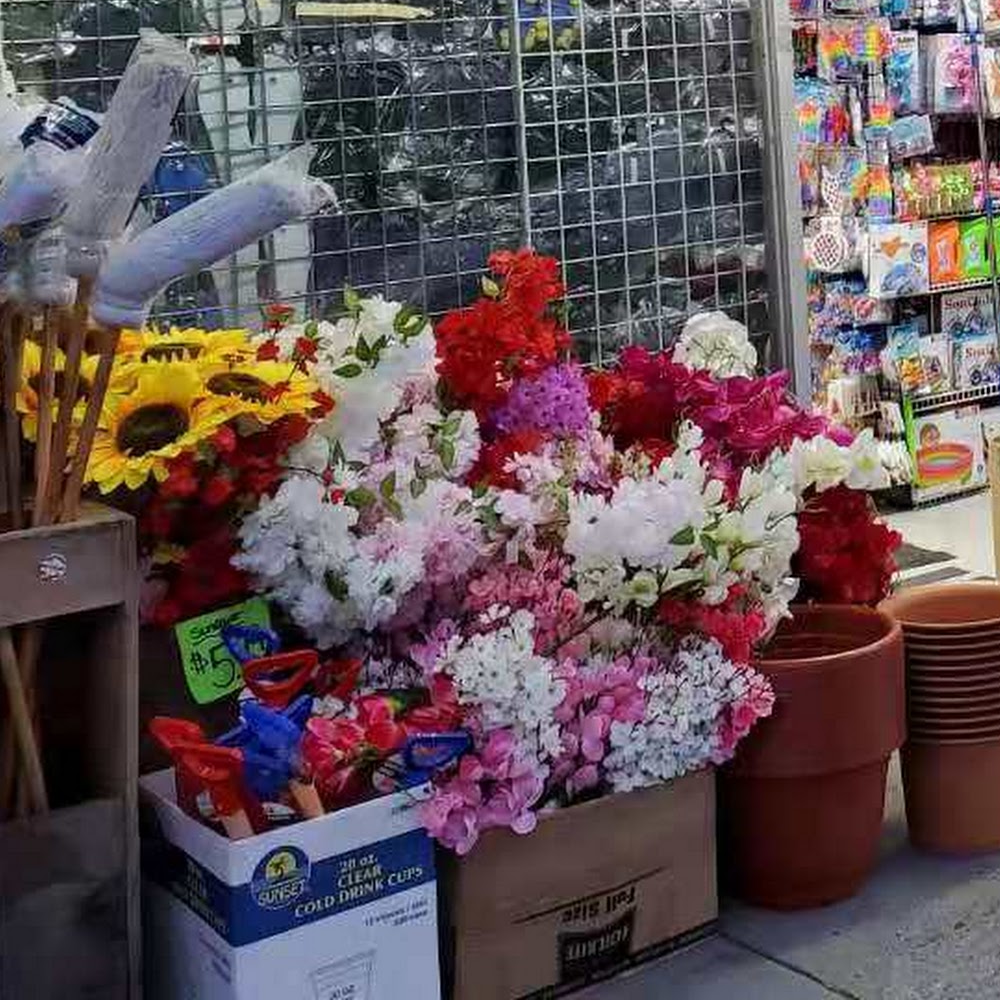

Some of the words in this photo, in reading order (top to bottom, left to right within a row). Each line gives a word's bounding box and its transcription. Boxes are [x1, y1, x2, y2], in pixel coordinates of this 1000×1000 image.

[337, 864, 382, 889] CLEAR
[257, 878, 306, 908] SUNSET
[294, 895, 336, 918] COLD
[339, 878, 385, 903] DRINK
[387, 867, 424, 887] CUPS
